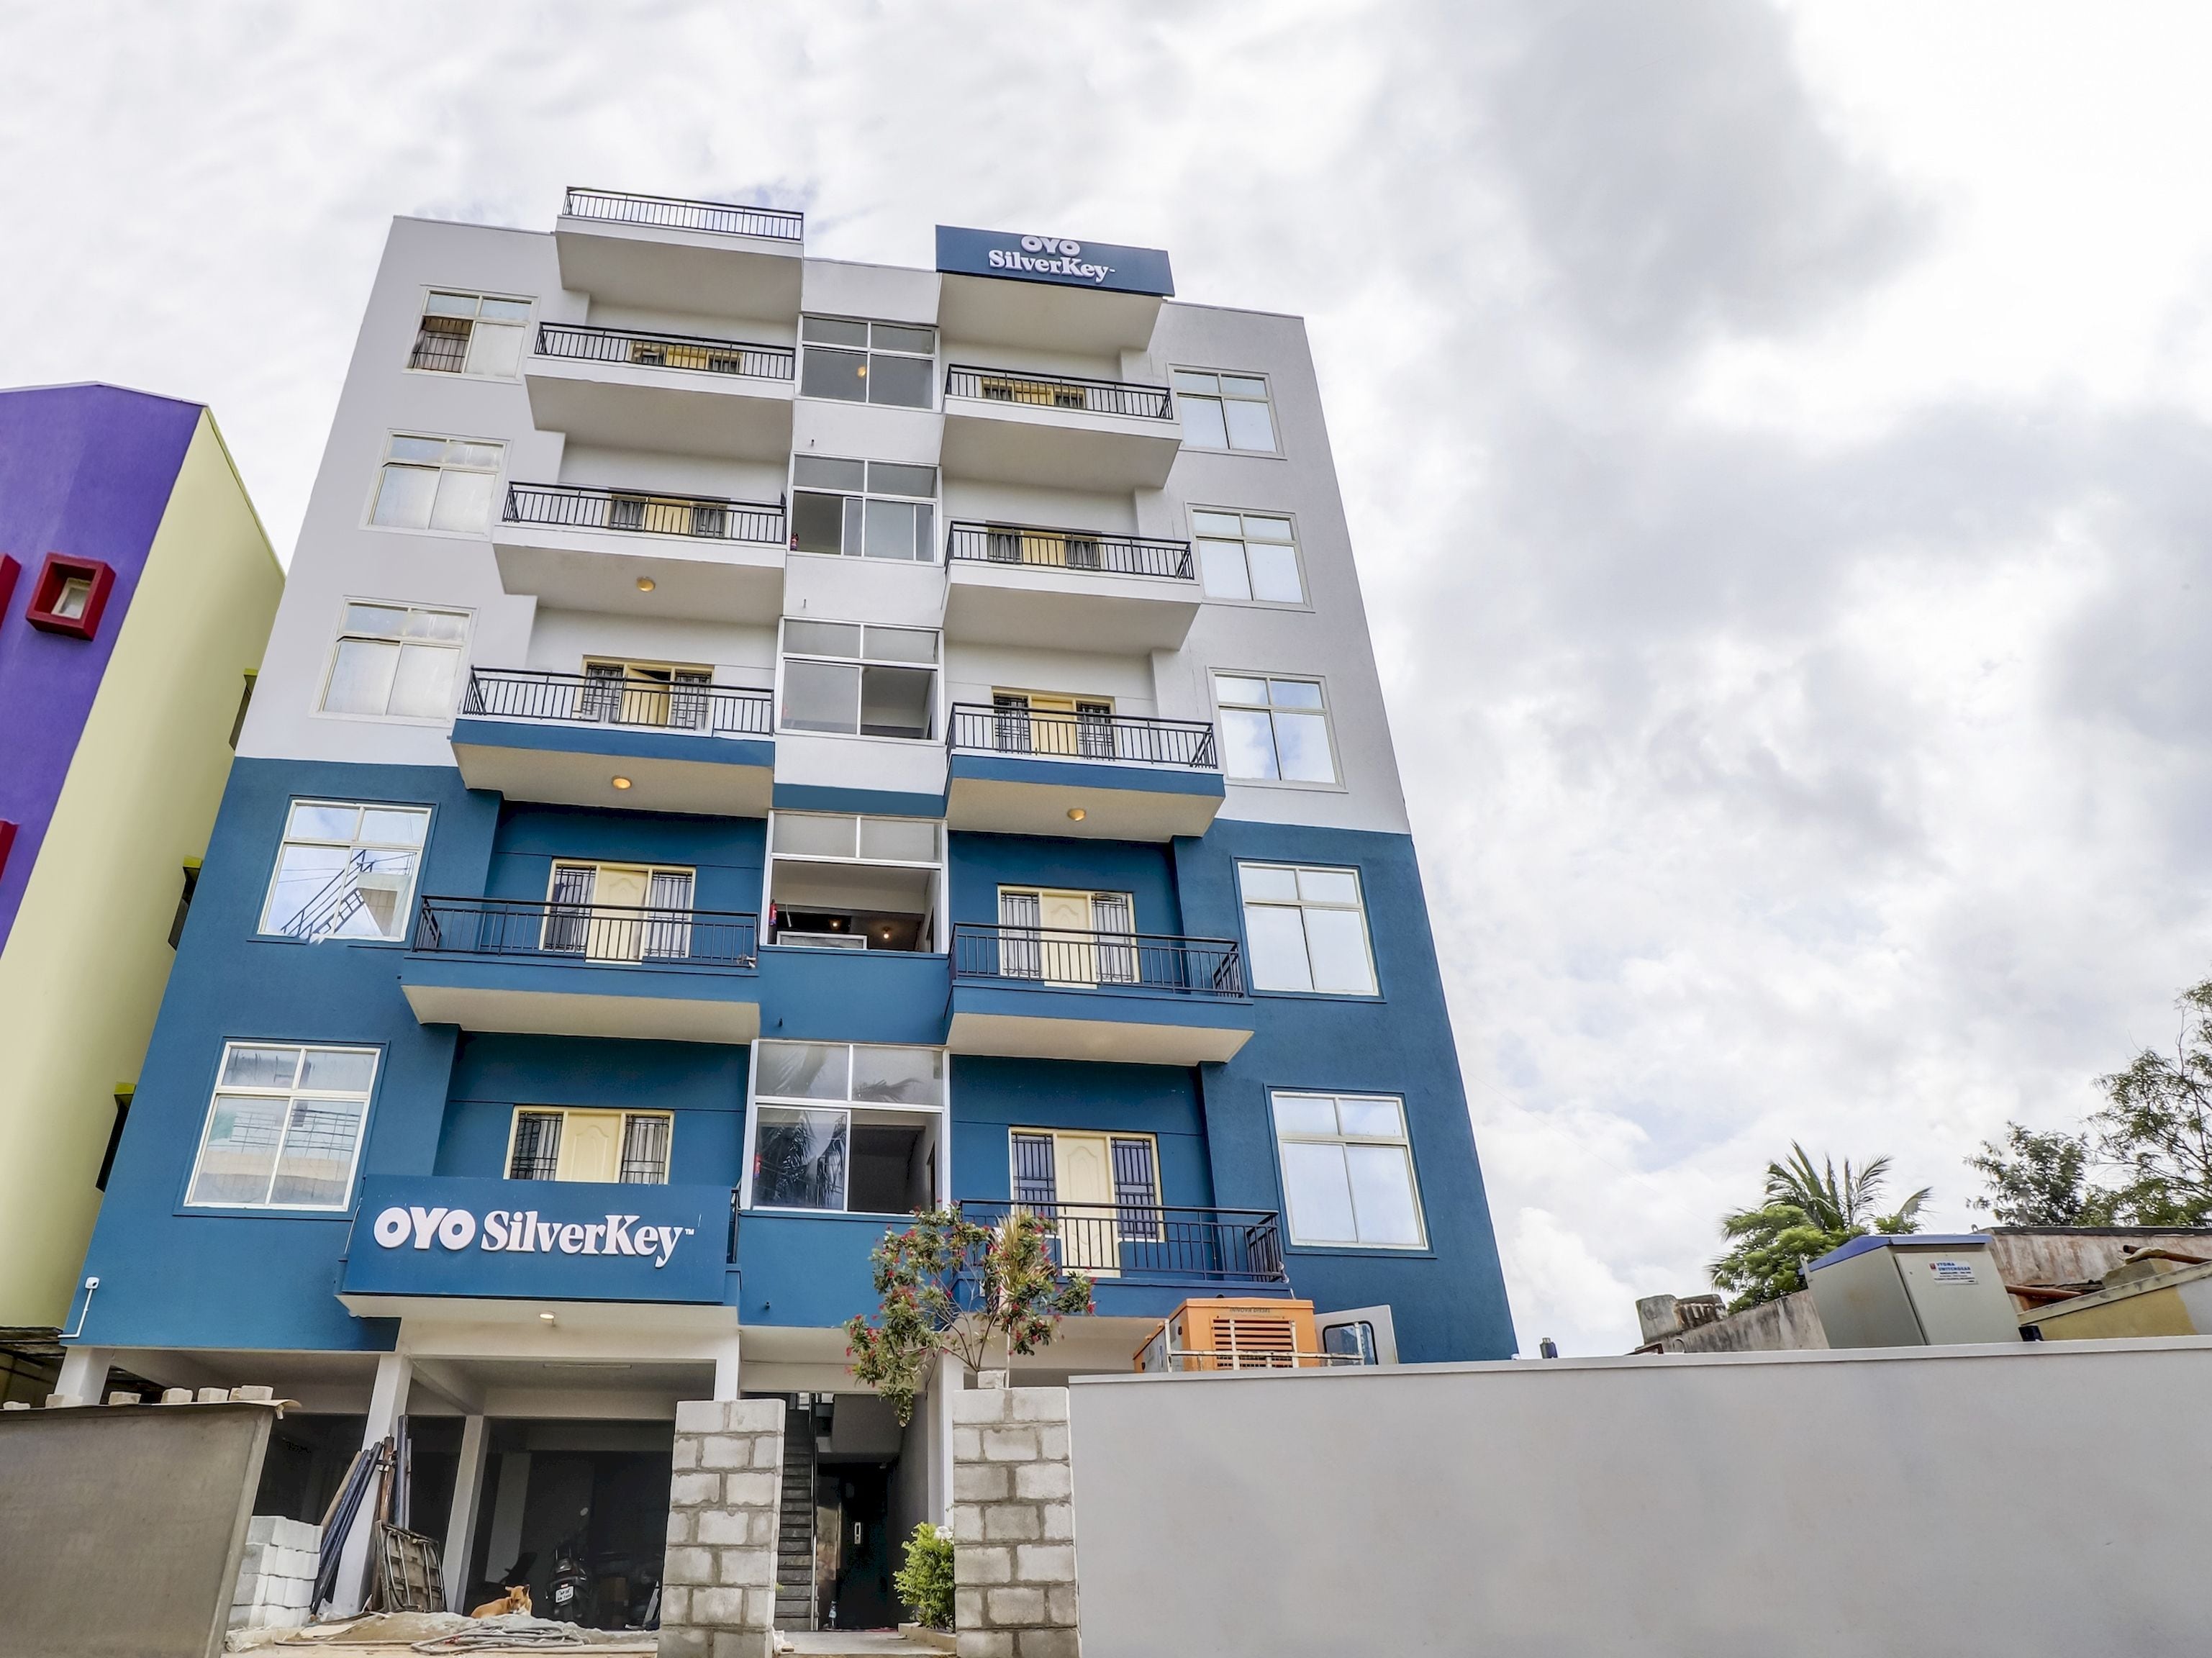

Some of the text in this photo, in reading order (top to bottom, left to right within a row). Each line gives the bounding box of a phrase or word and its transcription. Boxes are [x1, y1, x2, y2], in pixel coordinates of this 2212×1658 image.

[1020, 235, 1080, 257] OYO
[988, 250, 1110, 284] SilverKey
[373, 1206, 476, 1251] OYO
[480, 1210, 684, 1269] SilverKey
